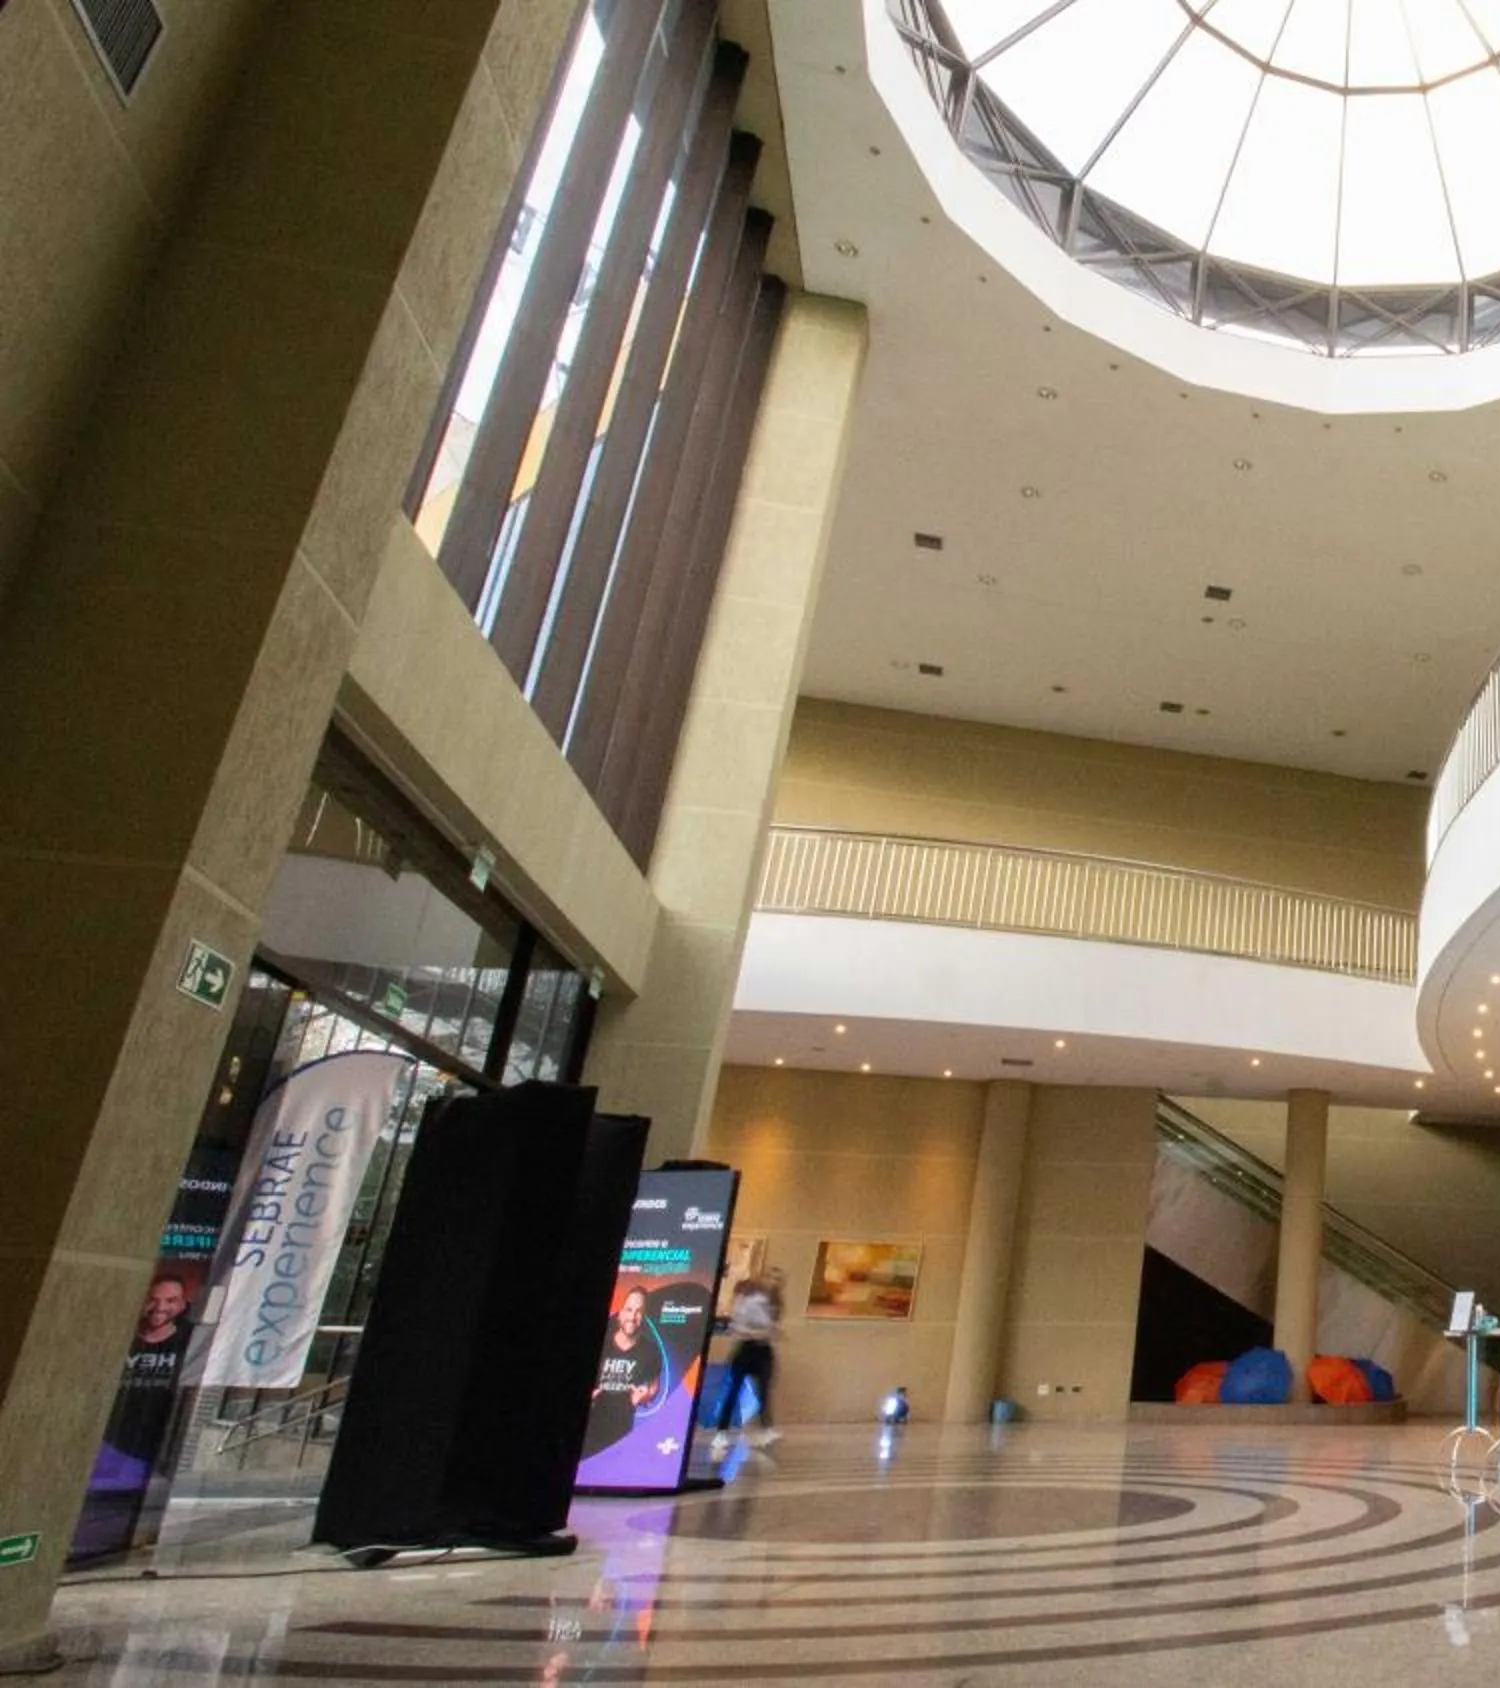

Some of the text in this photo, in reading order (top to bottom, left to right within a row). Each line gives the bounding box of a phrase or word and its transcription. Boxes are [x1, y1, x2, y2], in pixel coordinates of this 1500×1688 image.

[234, 1130, 308, 1268] SEBRAE
[245, 1105, 354, 1368] experience
[602, 1358, 637, 1373] HEY
